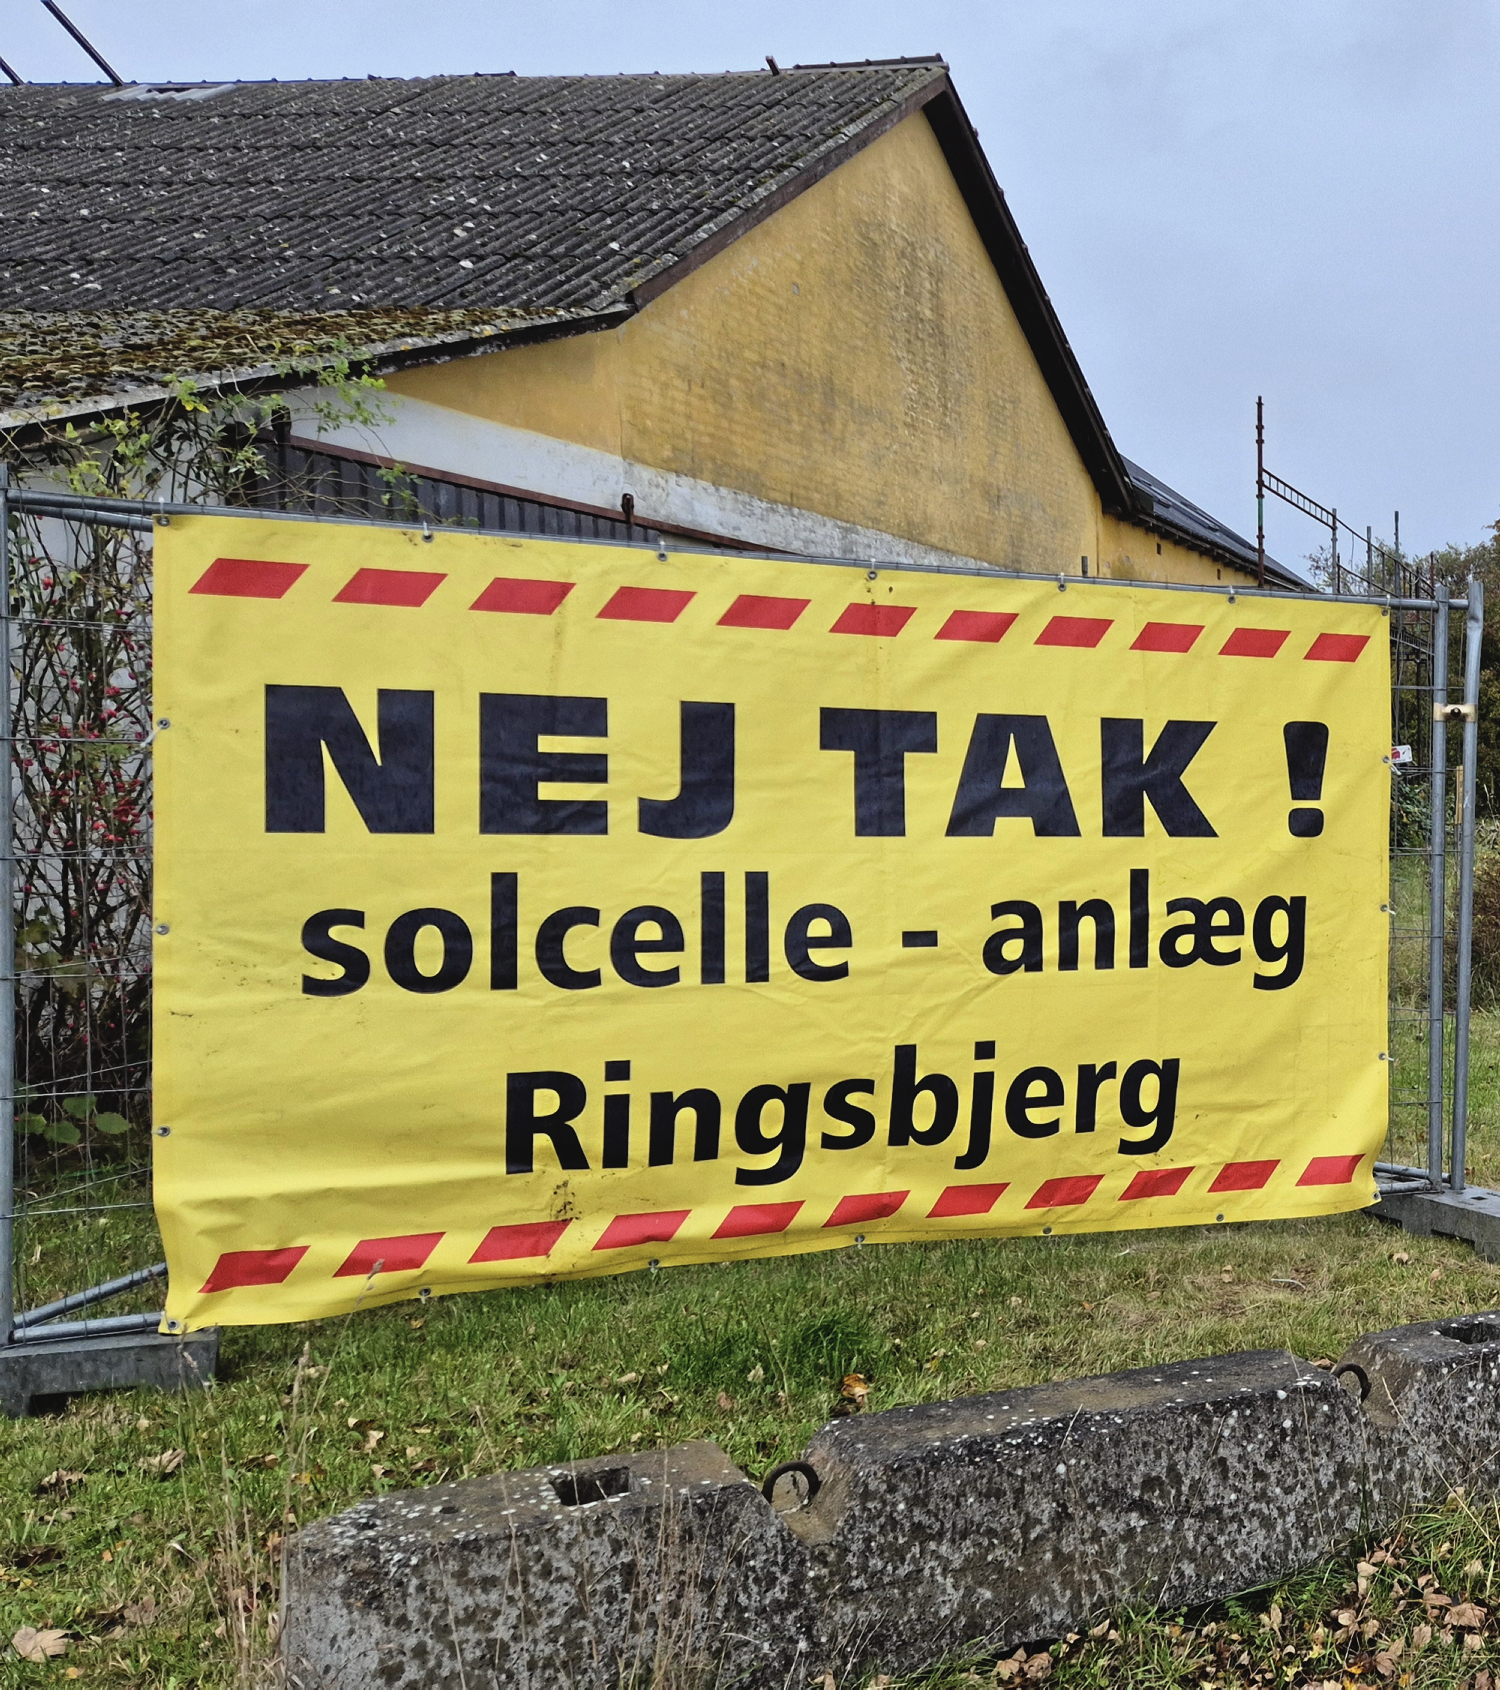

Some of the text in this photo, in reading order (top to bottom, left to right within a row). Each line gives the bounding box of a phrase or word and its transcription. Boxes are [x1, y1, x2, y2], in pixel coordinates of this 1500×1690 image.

[265, 684, 1330, 839] NEJ TAK !
[302, 868, 1307, 997] solcelle - anlæg
[506, 1040, 1180, 1187] Ringsbjerg
